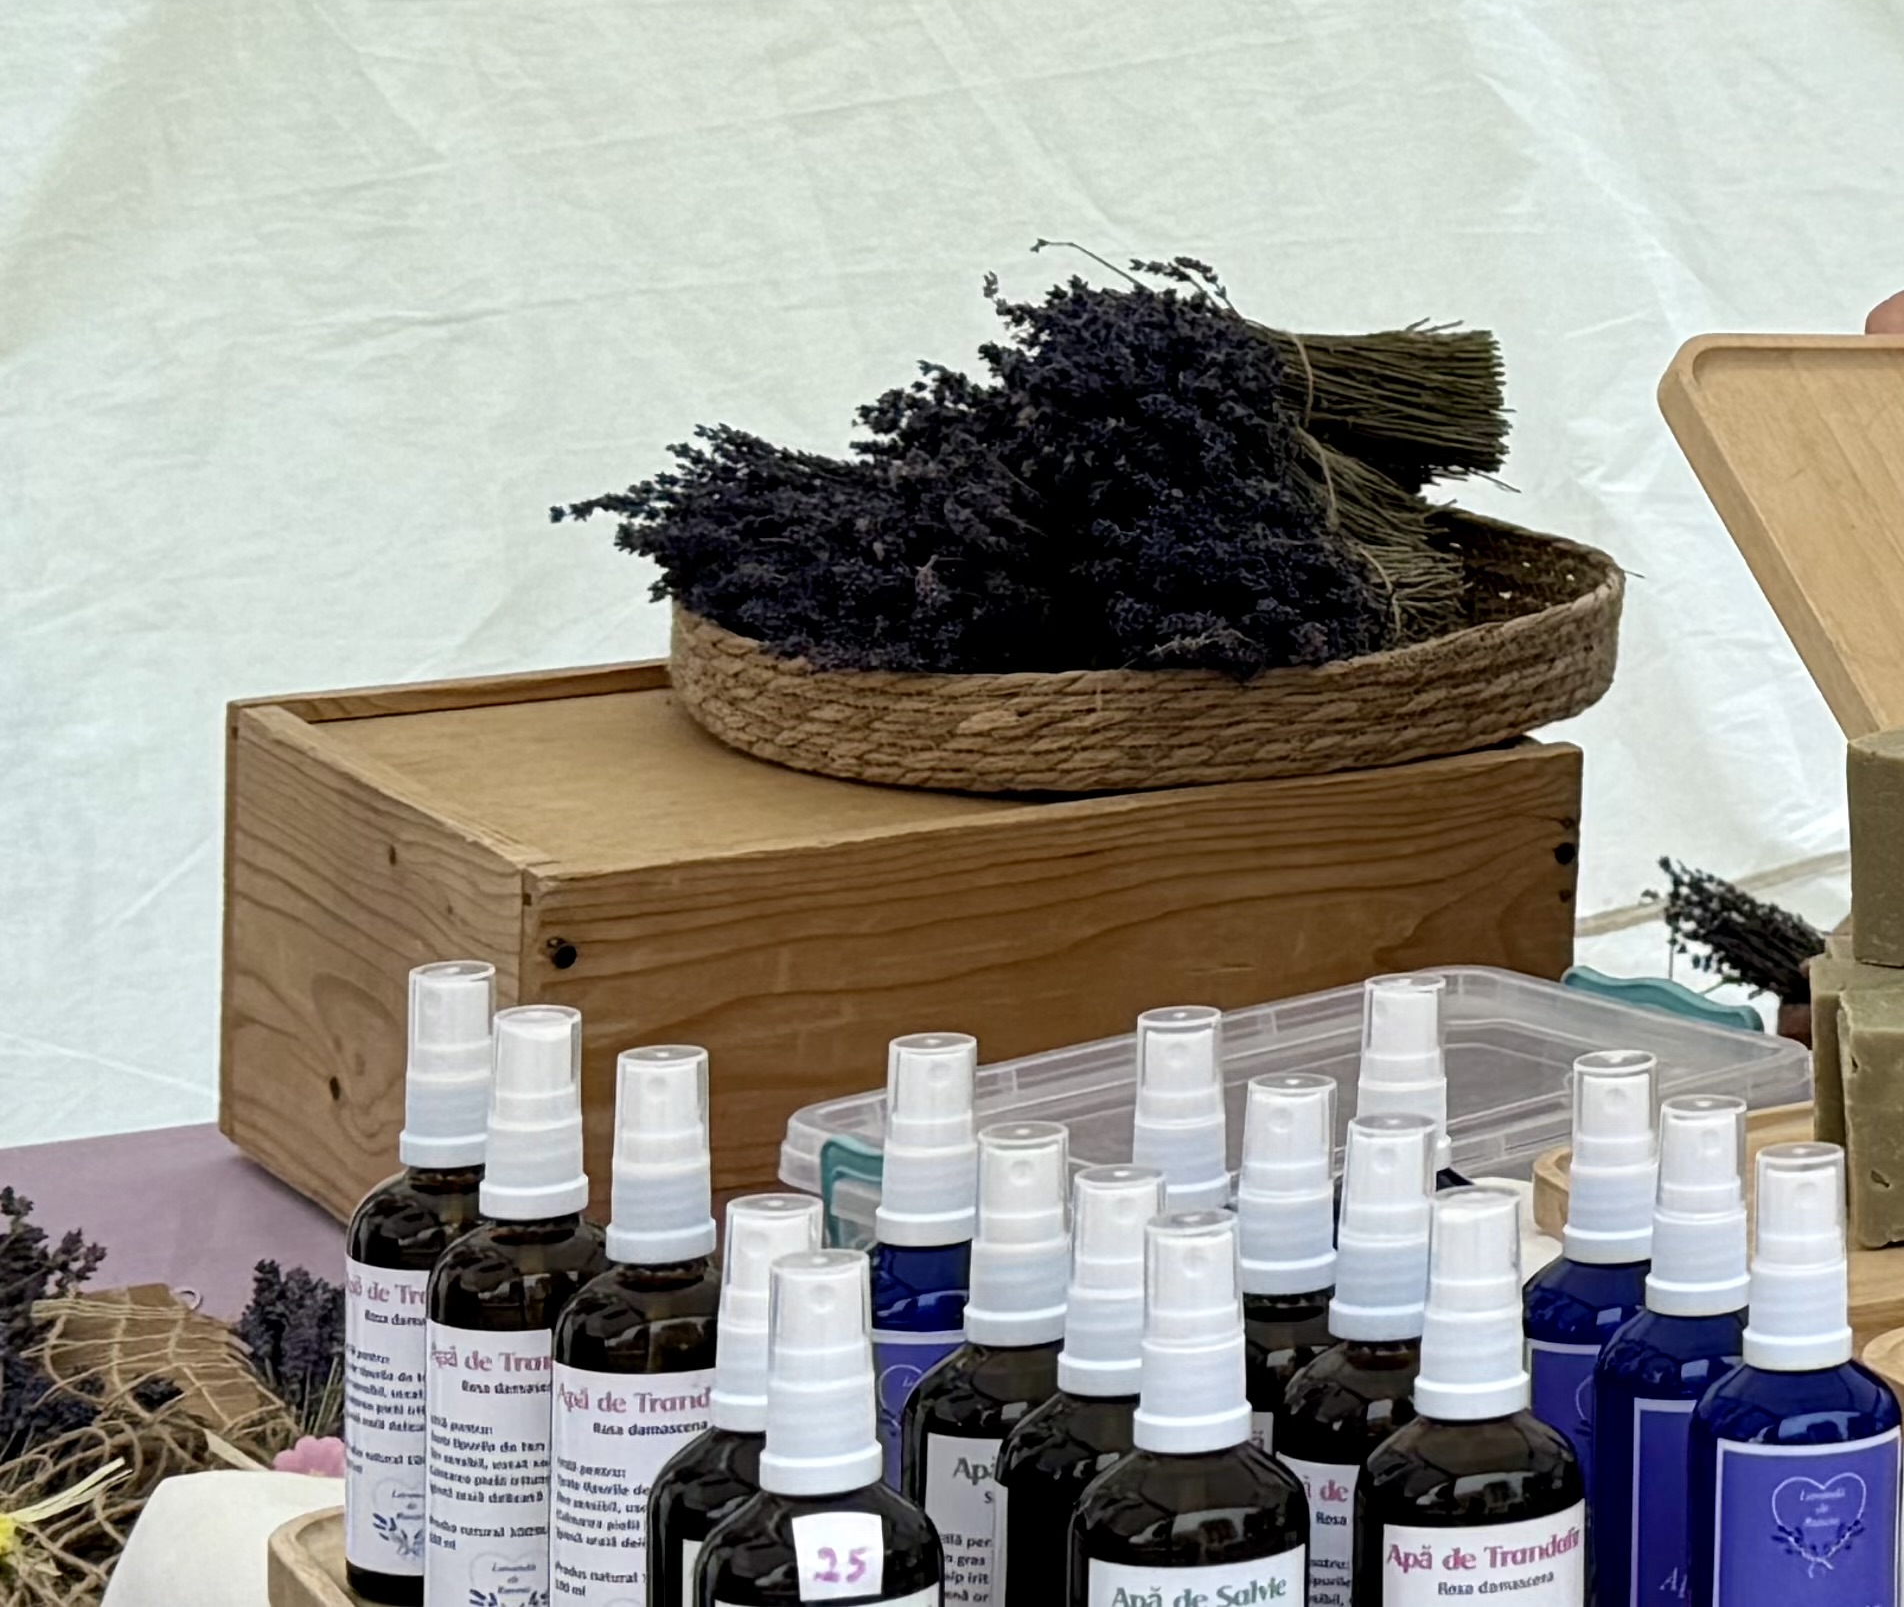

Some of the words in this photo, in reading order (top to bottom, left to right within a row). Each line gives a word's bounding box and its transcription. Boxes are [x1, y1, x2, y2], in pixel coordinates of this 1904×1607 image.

[464, 1349, 493, 1372] de
[597, 1390, 627, 1414] de
[1319, 1479, 1349, 1503] de
[1387, 1543, 1433, 1574] Apă
[1442, 1546, 1477, 1571] de
[1484, 1526, 1581, 1569] Trandafir
[813, 1546, 867, 1584] 25
[1173, 1588, 1209, 1607] de
[1216, 1575, 1287, 1607] Salvie
